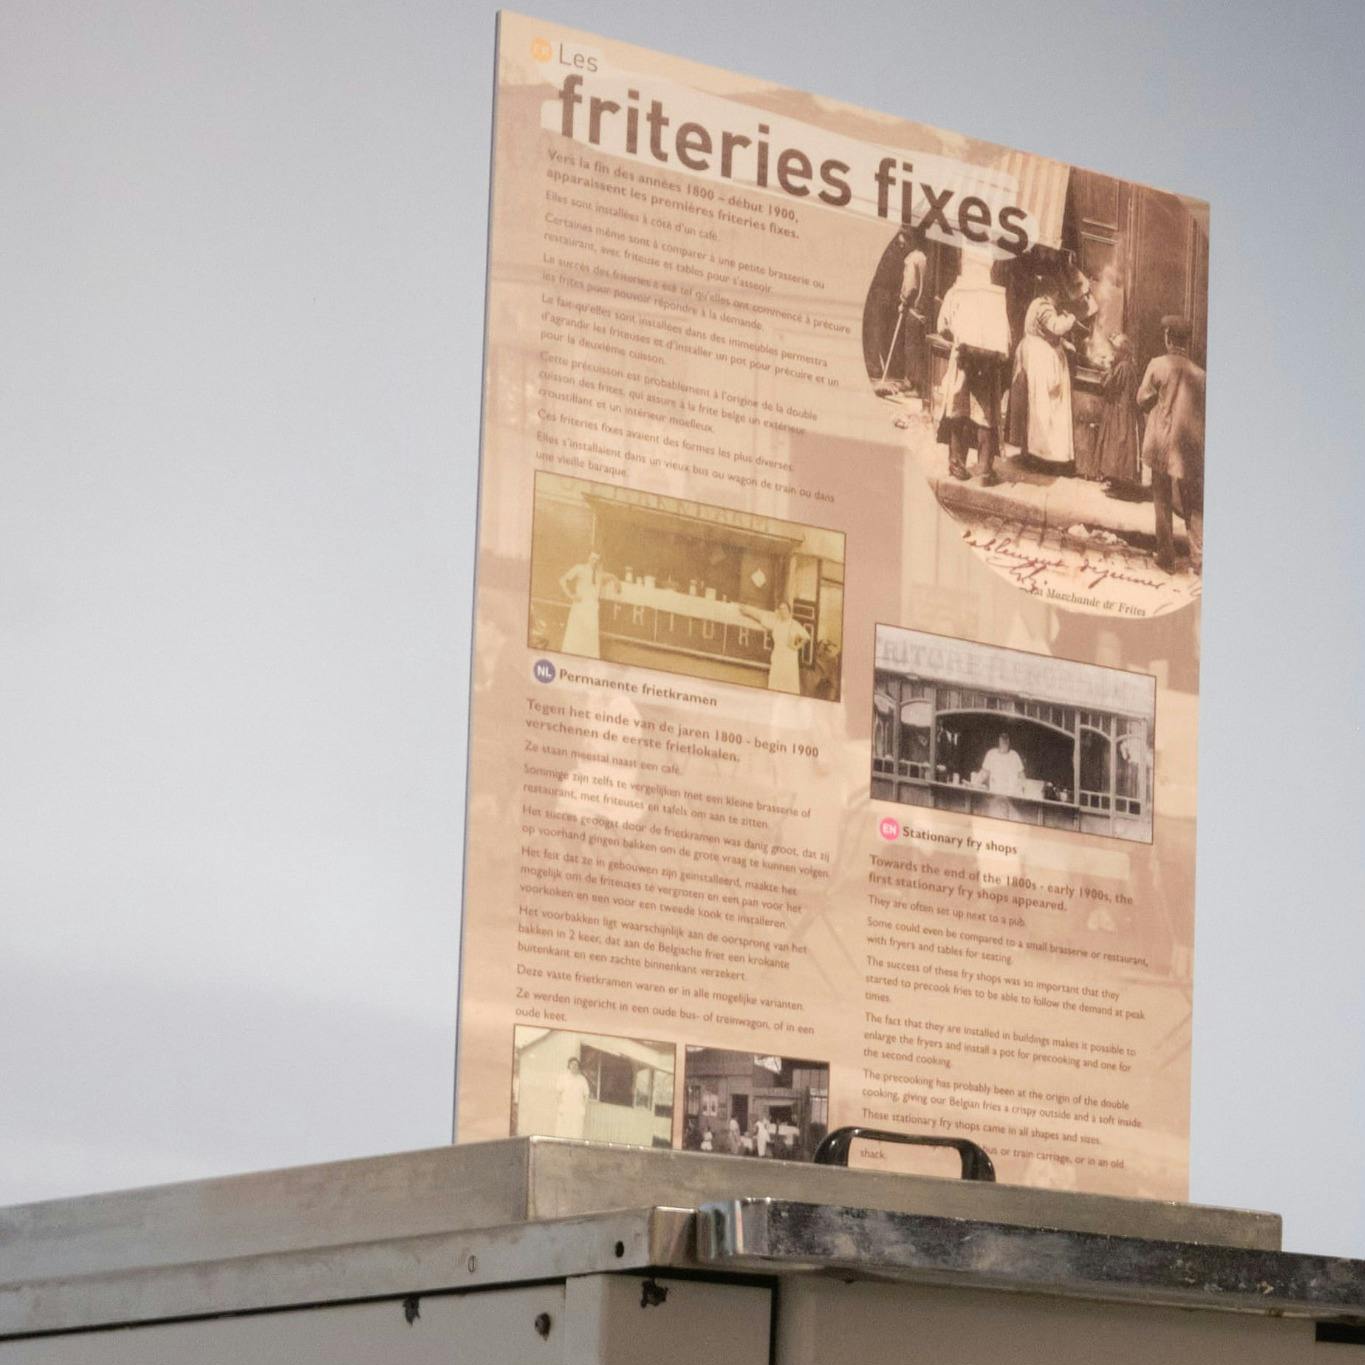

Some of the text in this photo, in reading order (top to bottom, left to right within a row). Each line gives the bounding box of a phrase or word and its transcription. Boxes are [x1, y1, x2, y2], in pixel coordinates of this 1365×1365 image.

[558, 43, 598, 72] Les
[559, 74, 1029, 253] friteries fixes
[545, 167, 800, 241] apparaissent les premières friteries fixes.
[546, 146, 800, 226] Vers la fin des années 1800 début 1900,
[545, 188, 568, 205] Elles
[570, 197, 592, 211] sont
[594, 200, 639, 223] installées
[650, 215, 672, 231] côté
[674, 220, 696, 237] d'un
[536, 407, 557, 423] Ces
[559, 411, 598, 432] friteries
[600, 420, 623, 437] fixes
[625, 428, 660, 445] avaient
[662, 433, 679, 449] des
[681, 437, 715, 456] formes
[717, 445, 731, 460] les
[732, 450, 753, 464] plus
[1118, 602, 1146, 617] Frites
[536, 665, 552, 678] NL
[557, 666, 718, 708] Permanente frietkramen
[525, 695, 820, 759] Tegen het einde van de jaren 1800 begin 1900
[525, 716, 741, 764] verschenen de eerste frietlokalen.
[524, 739, 538, 753] Ze
[541, 742, 568, 758] staan
[570, 749, 610, 765] meestal
[611, 756, 637, 769] naast
[639, 760, 658, 773] een
[881, 823, 897, 836] EN
[901, 823, 1018, 858] Stationary fry shops
[867, 869, 1068, 913] first stationary fry shops appeared.
[868, 851, 1134, 906] Towards the end of the 1800s early 1900s, the
[867, 893, 890, 911] They
[892, 899, 907, 910] are
[909, 900, 934, 914] often
[936, 904, 950, 917] set
[952, 908, 964, 922] up
[965, 910, 986, 922] next
[988, 911, 999, 924] to
[865, 933, 887, 947] with
[888, 935, 916, 952] fryers
[918, 941, 935, 953] and
[936, 942, 963, 957] tables
[965, 946, 977, 959] for
[515, 962, 543, 978] Deze
[546, 968, 572, 982] vaste
[574, 970, 633, 990] frietkramen
[635, 981, 665, 994] waren
[667, 985, 678, 996] er
[681, 984, 691, 998] in
[693, 986, 710, 1000] alle
[712, 991, 757, 1008] mogelijke
[863, 1029, 896, 1046] enlarge
[898, 1032, 913, 1046] the
[916, 1034, 943, 1051] fryers
[945, 1039, 962, 1052] and
[963, 1040, 990, 1056] install
[998, 1046, 1015, 1060] pot
[1016, 1047, 1029, 1061] for
[1031, 1052, 1081, 1070] precooking
[1082, 1057, 1099, 1070] and
[1100, 1061, 1116, 1072] one
[1118, 1060, 1132, 1074] for
[861, 1106, 888, 1121] These
[891, 1110, 936, 1130] stationary
[938, 1115, 951, 1131] fry
[954, 1118, 980, 1134] shops
[982, 1123, 1006, 1135] came
[1007, 1123, 1017, 1136] in
[1018, 1125, 1029, 1137] all
[1030, 1126, 1059, 1143] shapes
[1061, 1131, 1078, 1143] and
